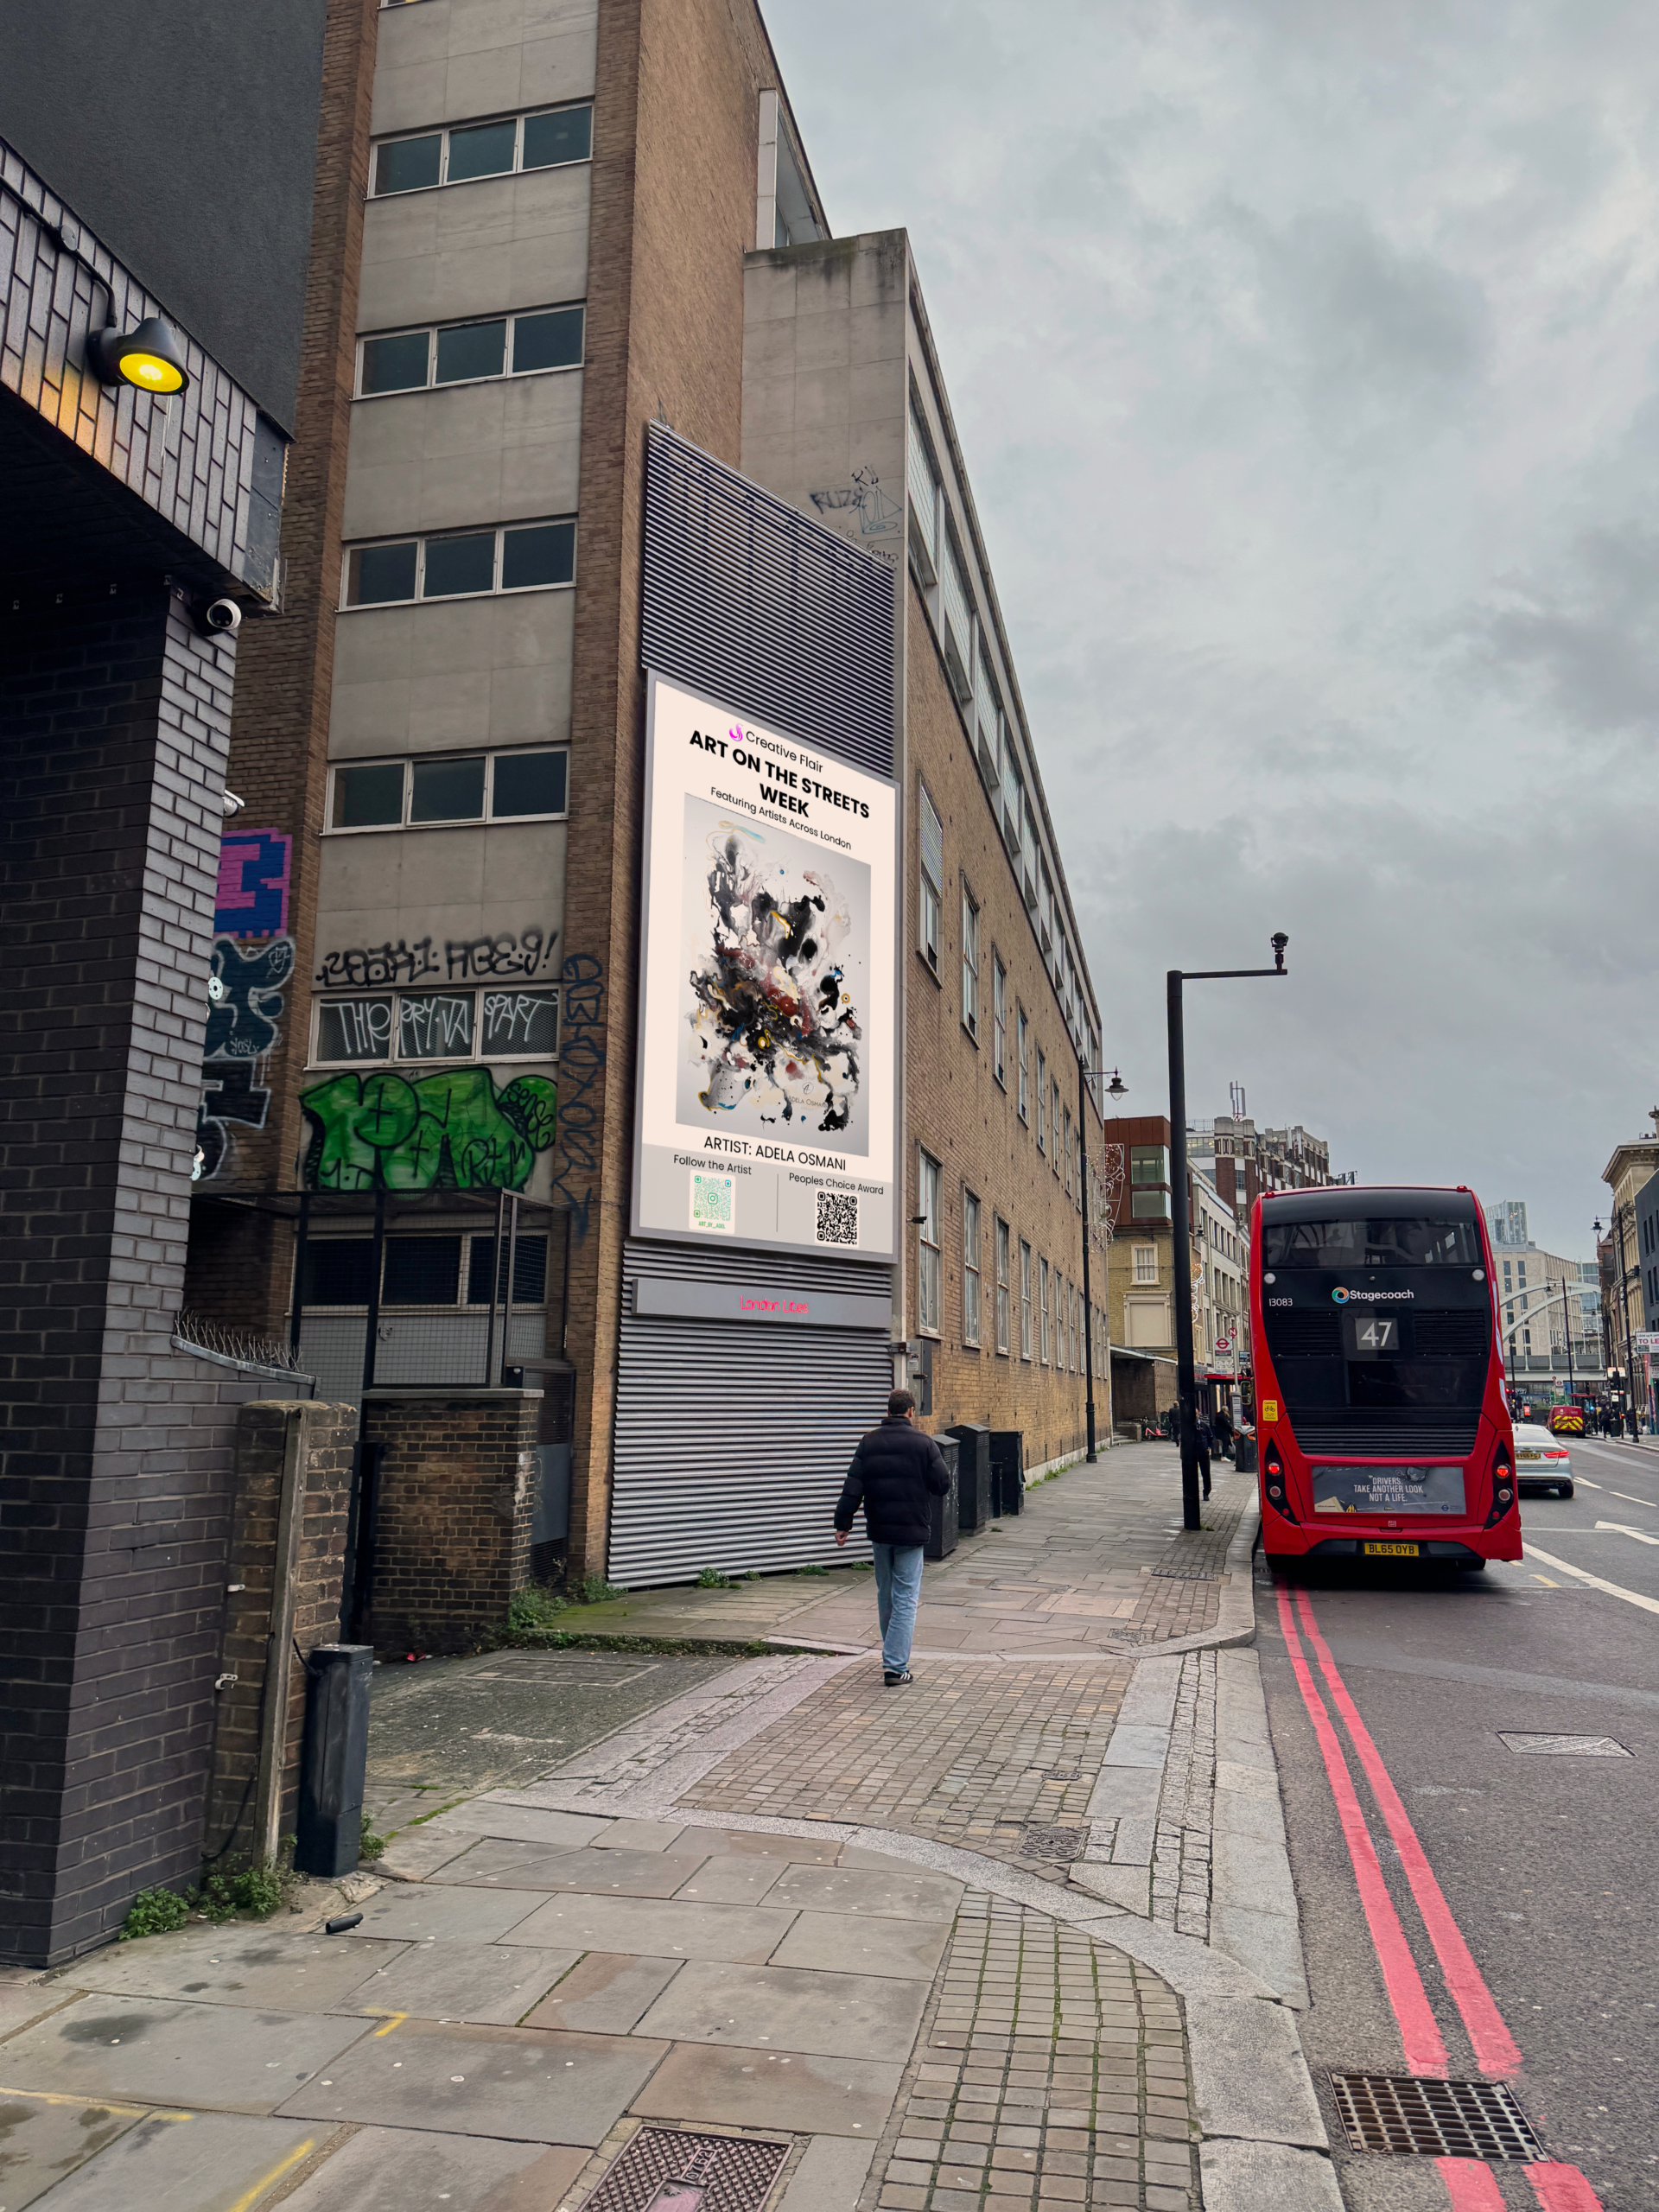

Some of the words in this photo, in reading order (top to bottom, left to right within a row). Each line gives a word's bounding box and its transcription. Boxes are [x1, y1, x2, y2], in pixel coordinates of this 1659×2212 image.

[746, 730, 797, 761] Creative
[799, 754, 823, 773] Flair
[690, 730, 728, 758] ART
[733, 748, 760, 772] ON
[765, 761, 798, 788] THE
[802, 778, 869, 819] STREETS
[760, 783, 809, 818] WEEK
[711, 786, 756, 814] Featuring
[759, 807, 787, 823] Artists
[789, 818, 818, 836] Across
[820, 830, 851, 850] London
[704, 1136, 752, 1155] ARTIST:
[756, 1145, 795, 1163] ADELA
[798, 1153, 846, 1171] OSMANI
[674, 1154, 706, 1168] Follow
[709, 1160, 724, 1171] the
[727, 1164, 752, 1175] Artist
[789, 1173, 824, 1186] Peoples
[826, 1179, 855, 1191] Choice
[858, 1184, 884, 1195] Award
[740, 1295, 780, 1312] London
[1268, 1298, 1294, 1306] 13083
[1350, 1289, 1414, 1302] Stagecoach
[1361, 1321, 1393, 1347] 47
[1353, 1484, 1370, 1493] TAKE
[1372, 1484, 1403, 1493] ANOTHER
[1405, 1485, 1424, 1494] LOOK
[1372, 1477, 1403, 1485] DRIVERS.
[1369, 1493, 1382, 1502] NOT
[1384, 1493, 1390, 1502] A
[1391, 1493, 1408, 1502] LIFE.
[1369, 1544, 1394, 1554] BL65
[1395, 1545, 1414, 1554] OYB
